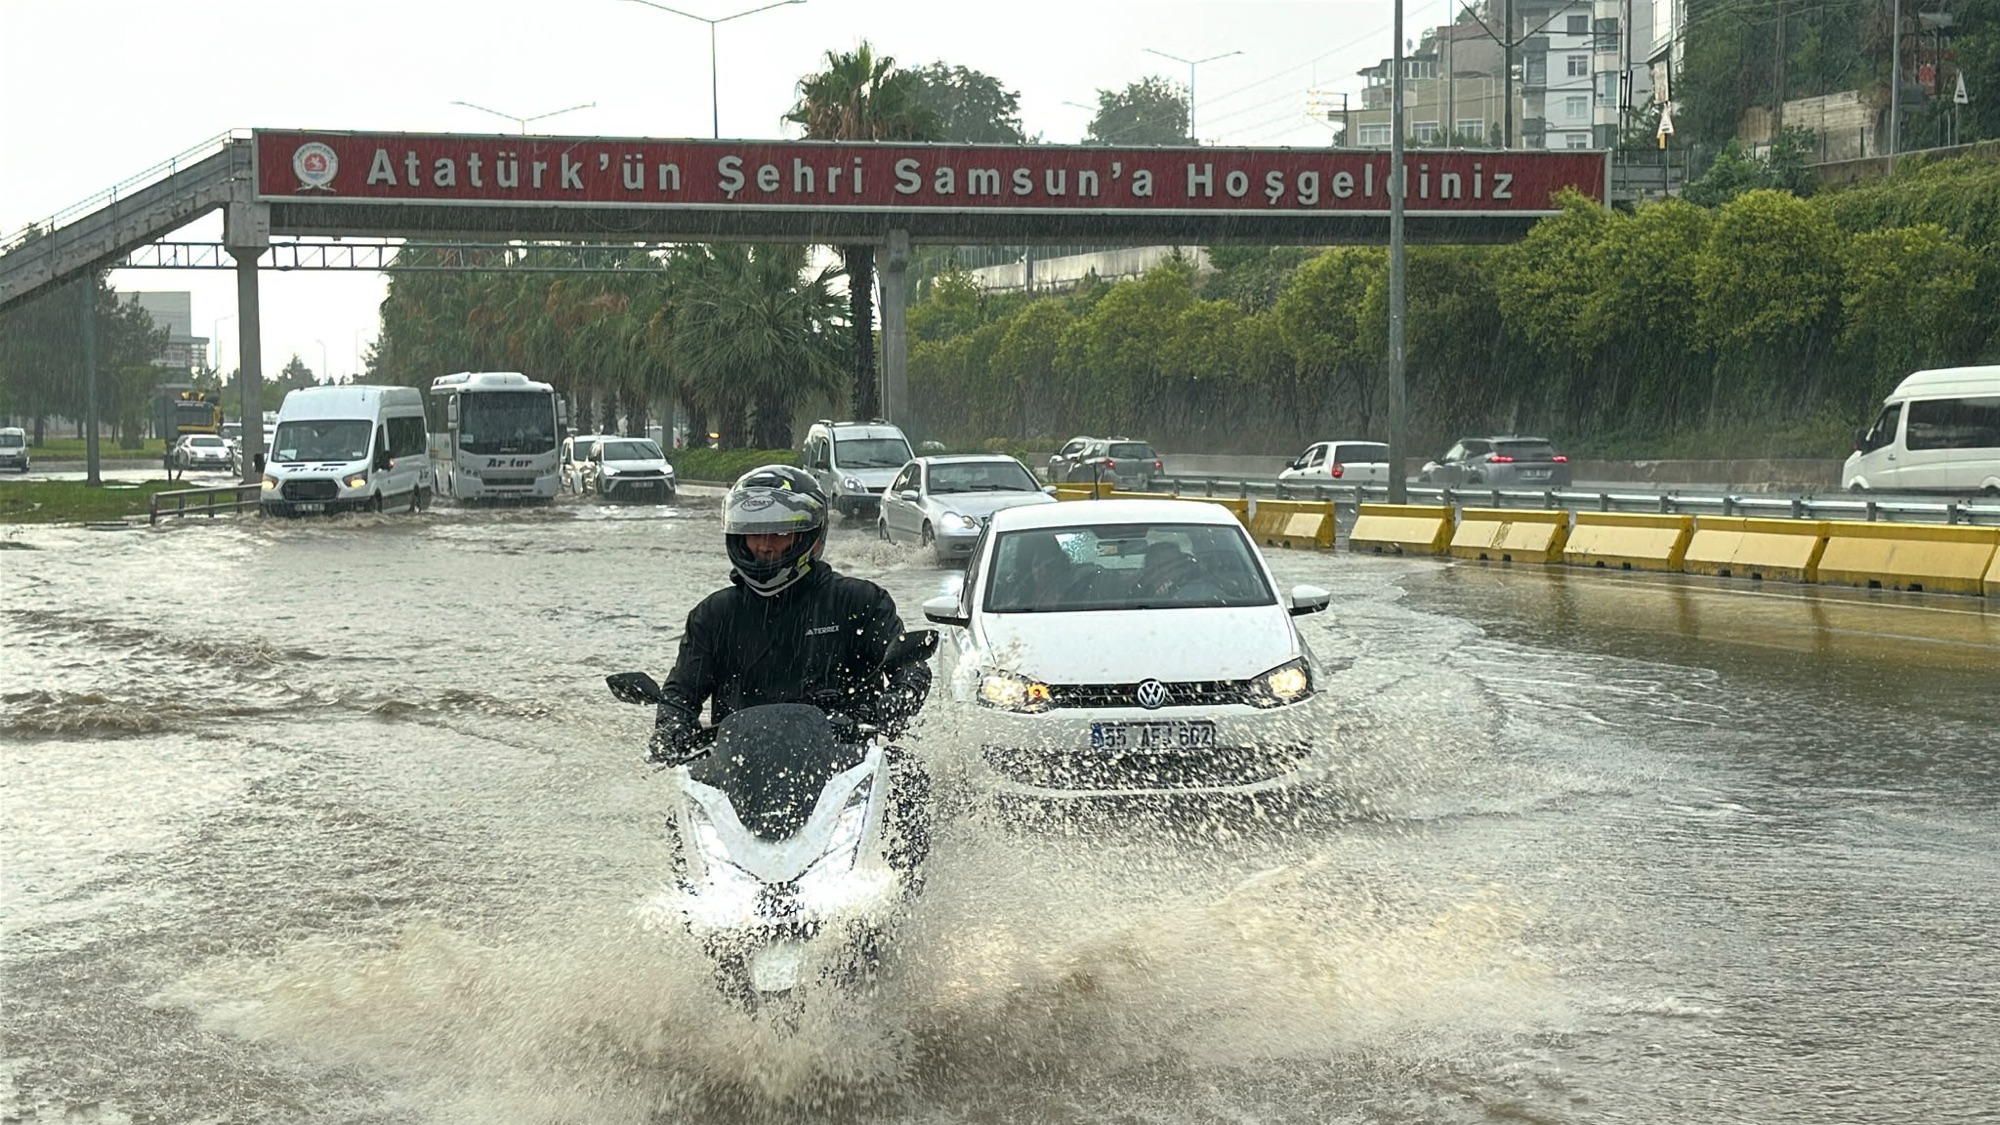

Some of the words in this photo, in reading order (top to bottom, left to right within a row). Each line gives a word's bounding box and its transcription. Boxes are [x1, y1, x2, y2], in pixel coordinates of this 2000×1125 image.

[717, 155, 863, 200] Şehri
[487, 458, 505, 468] Ar
[813, 625, 840, 635] TERREX
[1105, 728, 1126, 747] 55
[1179, 726, 1211, 746] 602
